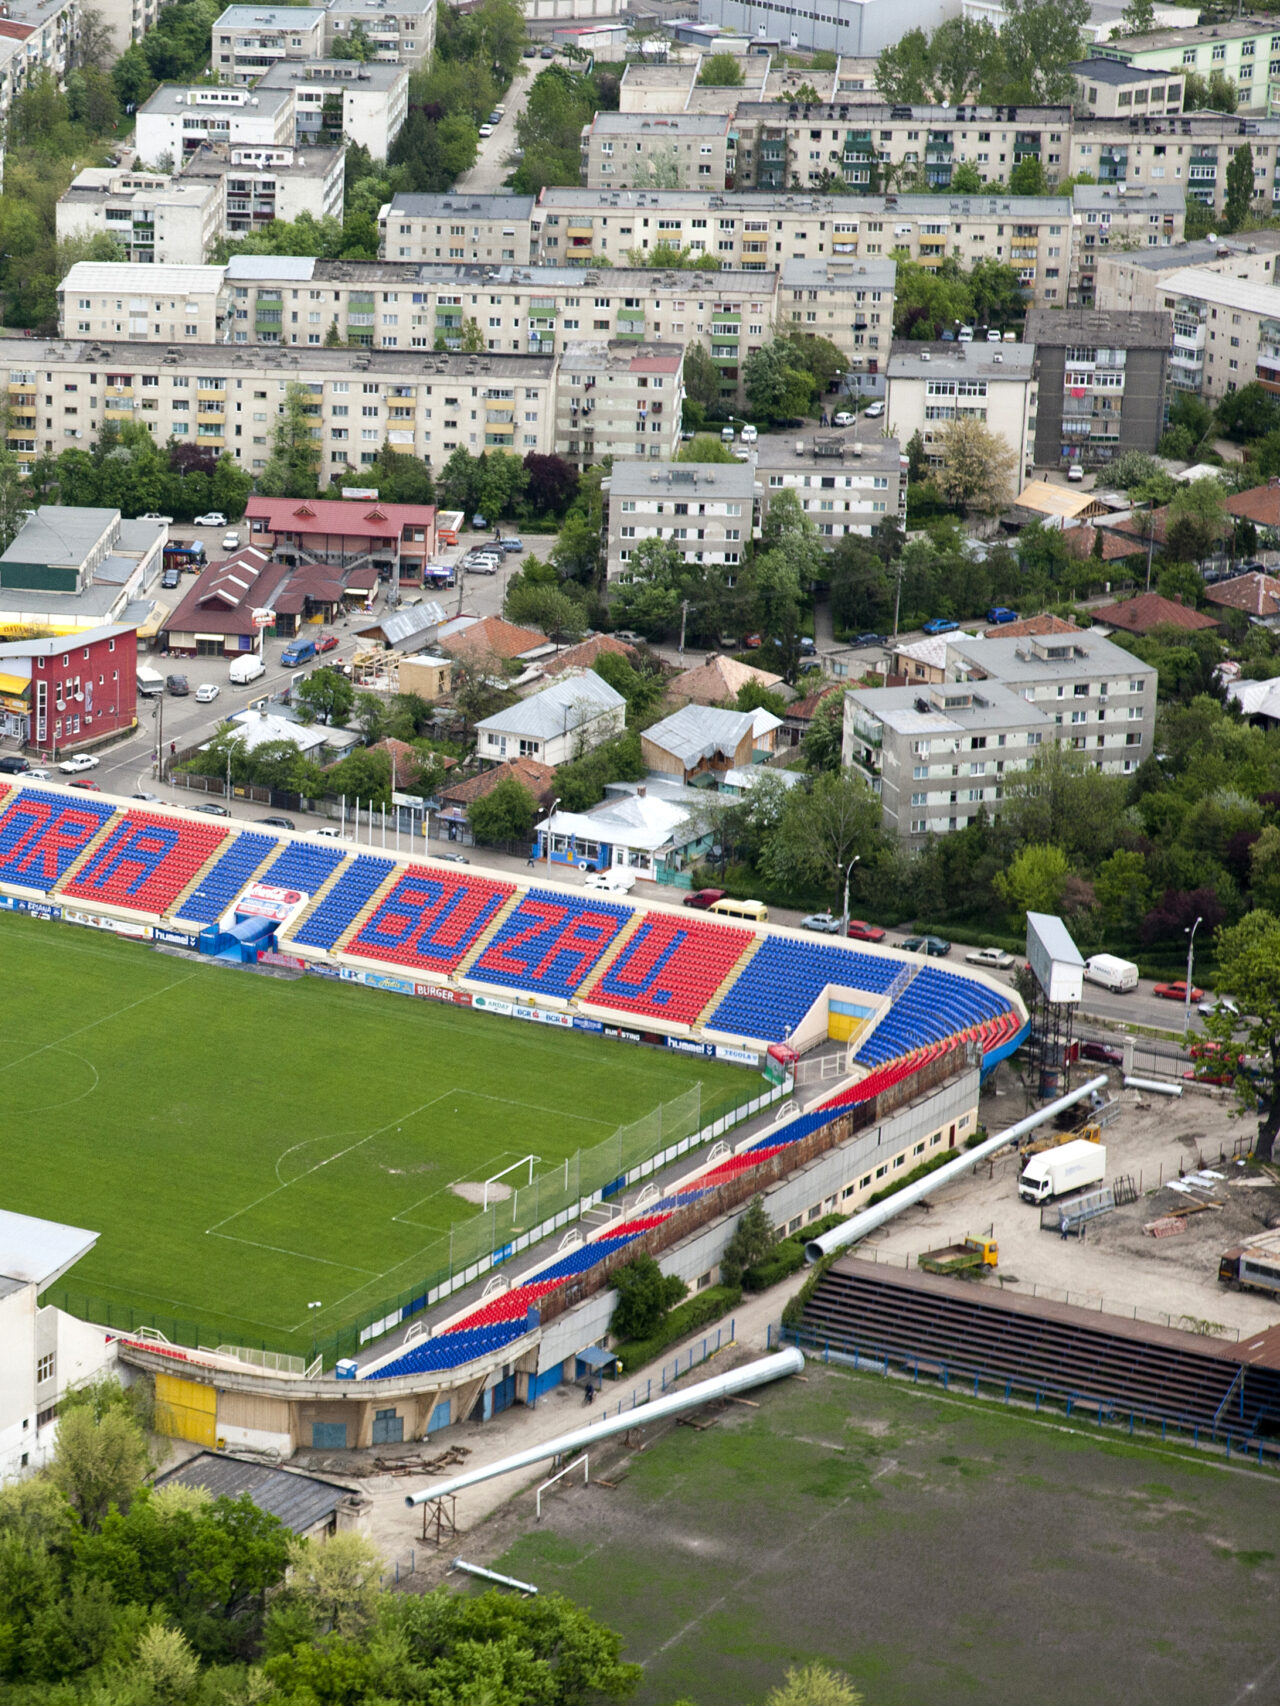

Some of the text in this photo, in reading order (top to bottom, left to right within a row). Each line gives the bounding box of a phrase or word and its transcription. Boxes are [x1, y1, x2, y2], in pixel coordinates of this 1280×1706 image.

[155, 929, 189, 946] hummel
[417, 985, 454, 1001] BURGER
[517, 1009, 531, 1018] BCR
[546, 1015, 560, 1023] BCR
[668, 1036, 705, 1054] hummel
